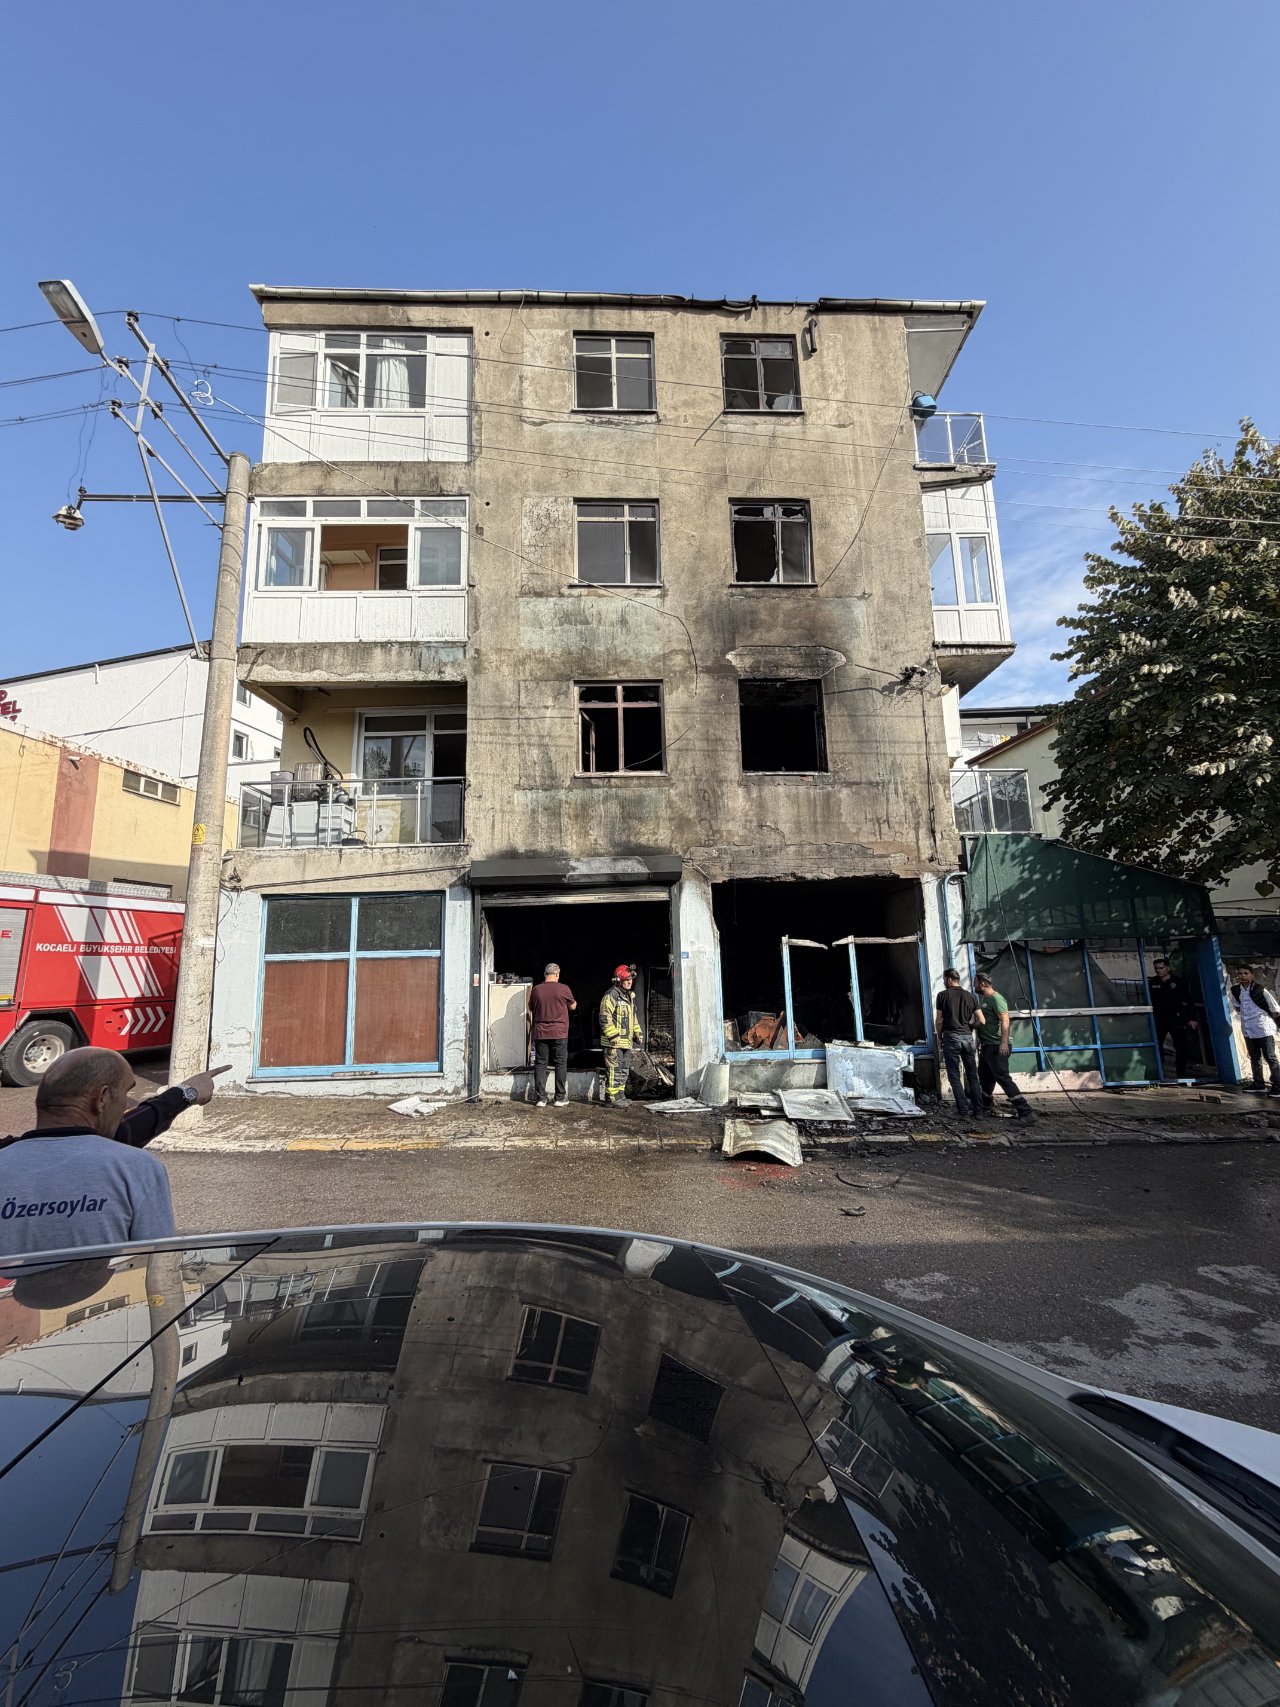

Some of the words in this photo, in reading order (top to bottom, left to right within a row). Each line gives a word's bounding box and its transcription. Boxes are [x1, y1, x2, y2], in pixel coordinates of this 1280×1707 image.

[36, 943, 77, 952] KOCAELİ
[79, 944, 133, 954] BÜYÜKŞEHİR
[134, 945, 176, 954] BELEDİYESİ
[1, 1194, 108, 1220] Özersoylar
